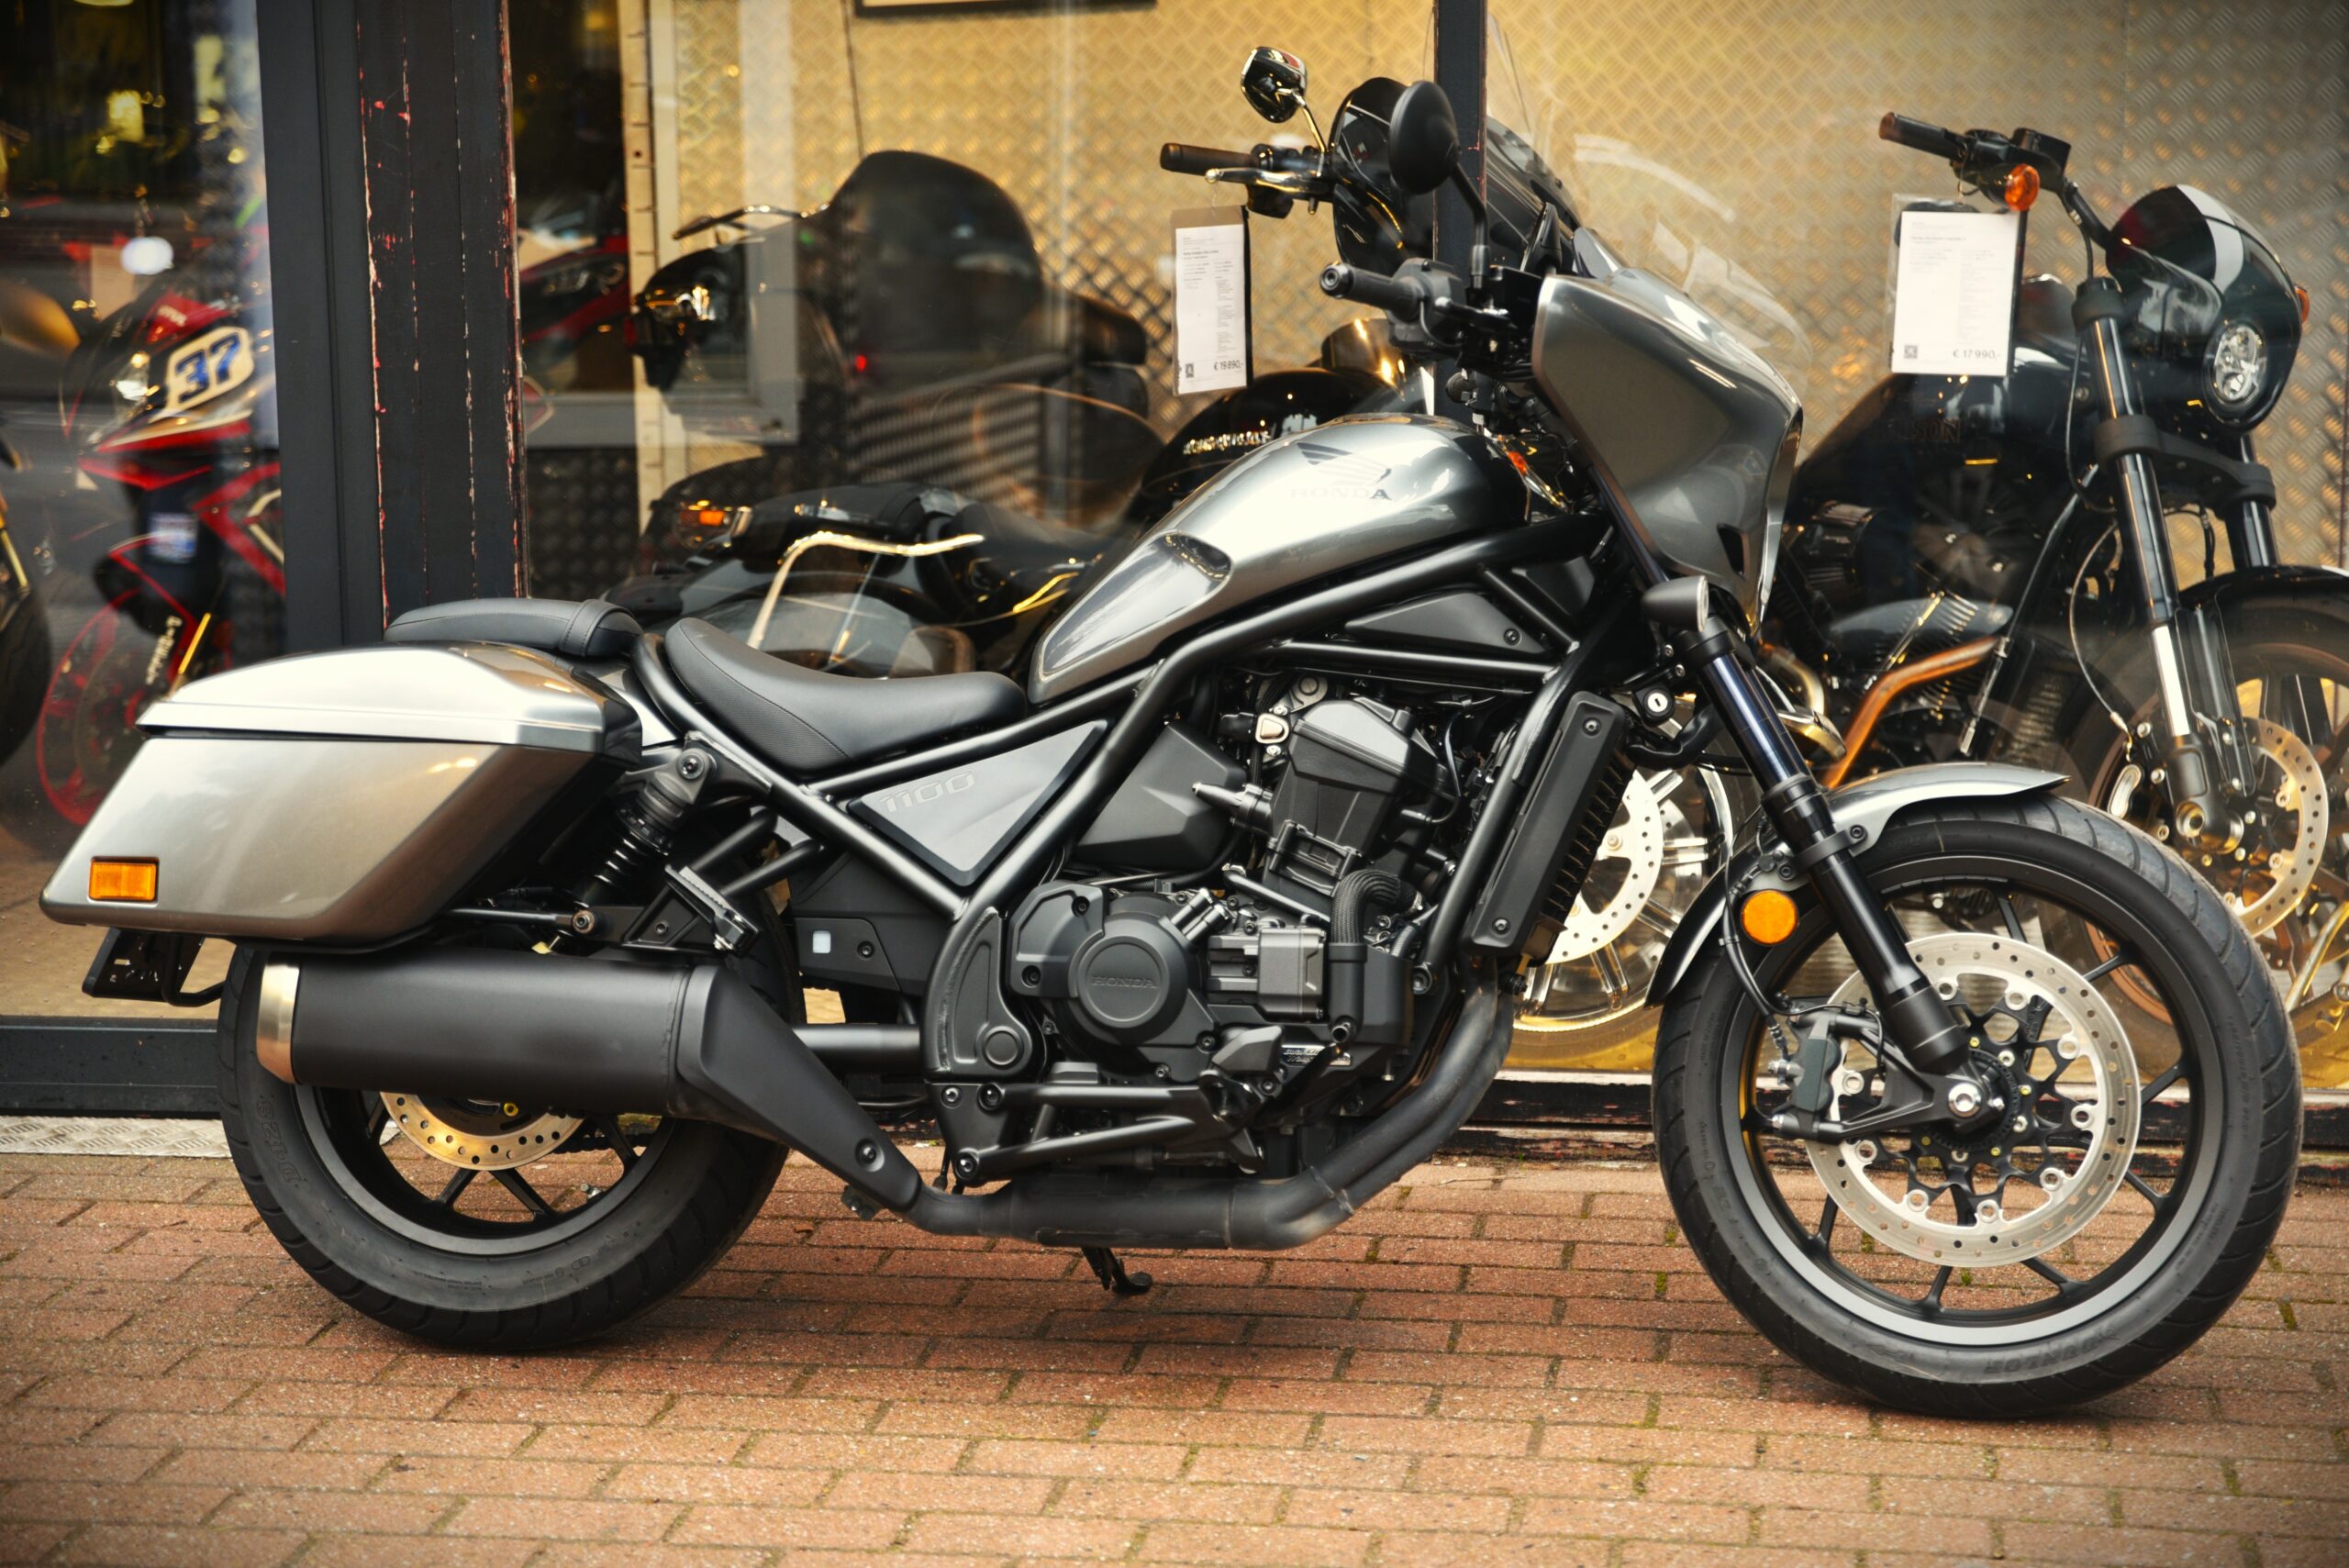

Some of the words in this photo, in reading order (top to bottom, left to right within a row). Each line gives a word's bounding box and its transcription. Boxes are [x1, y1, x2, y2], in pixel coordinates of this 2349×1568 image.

[174, 331, 241, 405] 37
[1290, 486, 1393, 501] HONDA
[880, 772, 976, 814] 1100
[1091, 975, 1160, 990] HONDA
